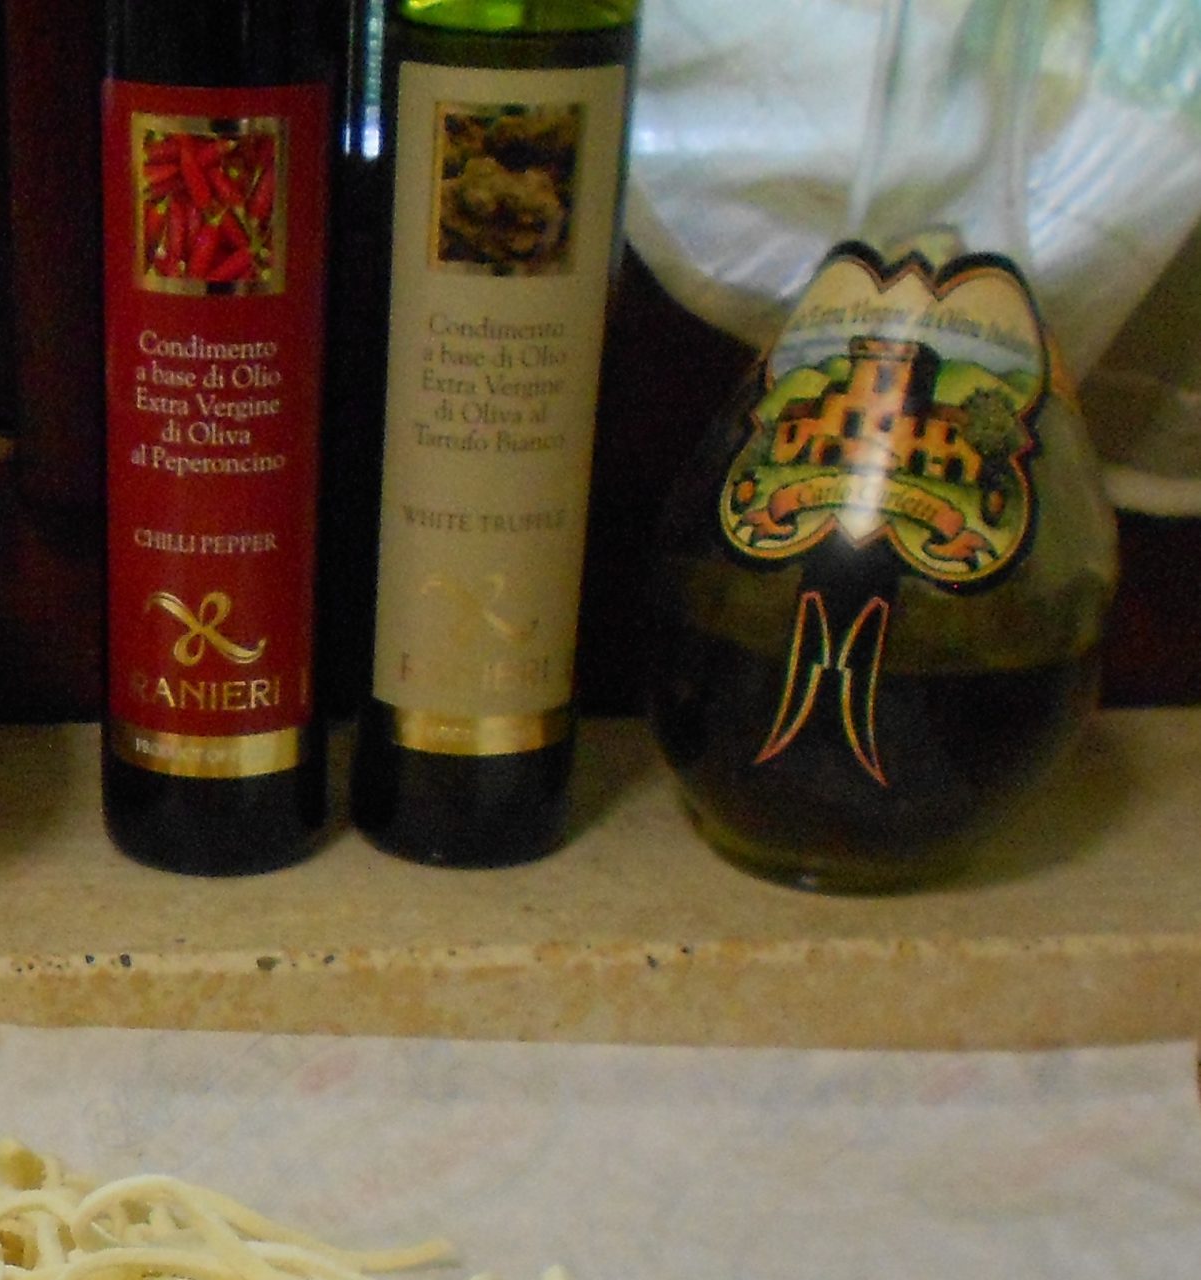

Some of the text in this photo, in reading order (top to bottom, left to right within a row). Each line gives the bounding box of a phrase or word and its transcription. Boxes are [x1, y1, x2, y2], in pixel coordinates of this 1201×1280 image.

[429, 311, 564, 340] Condimento
[139, 329, 277, 359] Condimento
[440, 342, 485, 367] base
[493, 346, 513, 369] di
[136, 360, 282, 389] a base di Olio
[422, 368, 565, 400] Extra Vergine
[137, 386, 280, 422] Extra Vergine
[434, 398, 454, 422] di
[460, 402, 523, 426] Oliva
[161, 419, 251, 445] di Oliva
[131, 444, 285, 477] al Peperoncino
[402, 504, 472, 533] WHITE
[134, 528, 278, 555] CHILLI PEPPER
[130, 671, 280, 711] RANIERI
